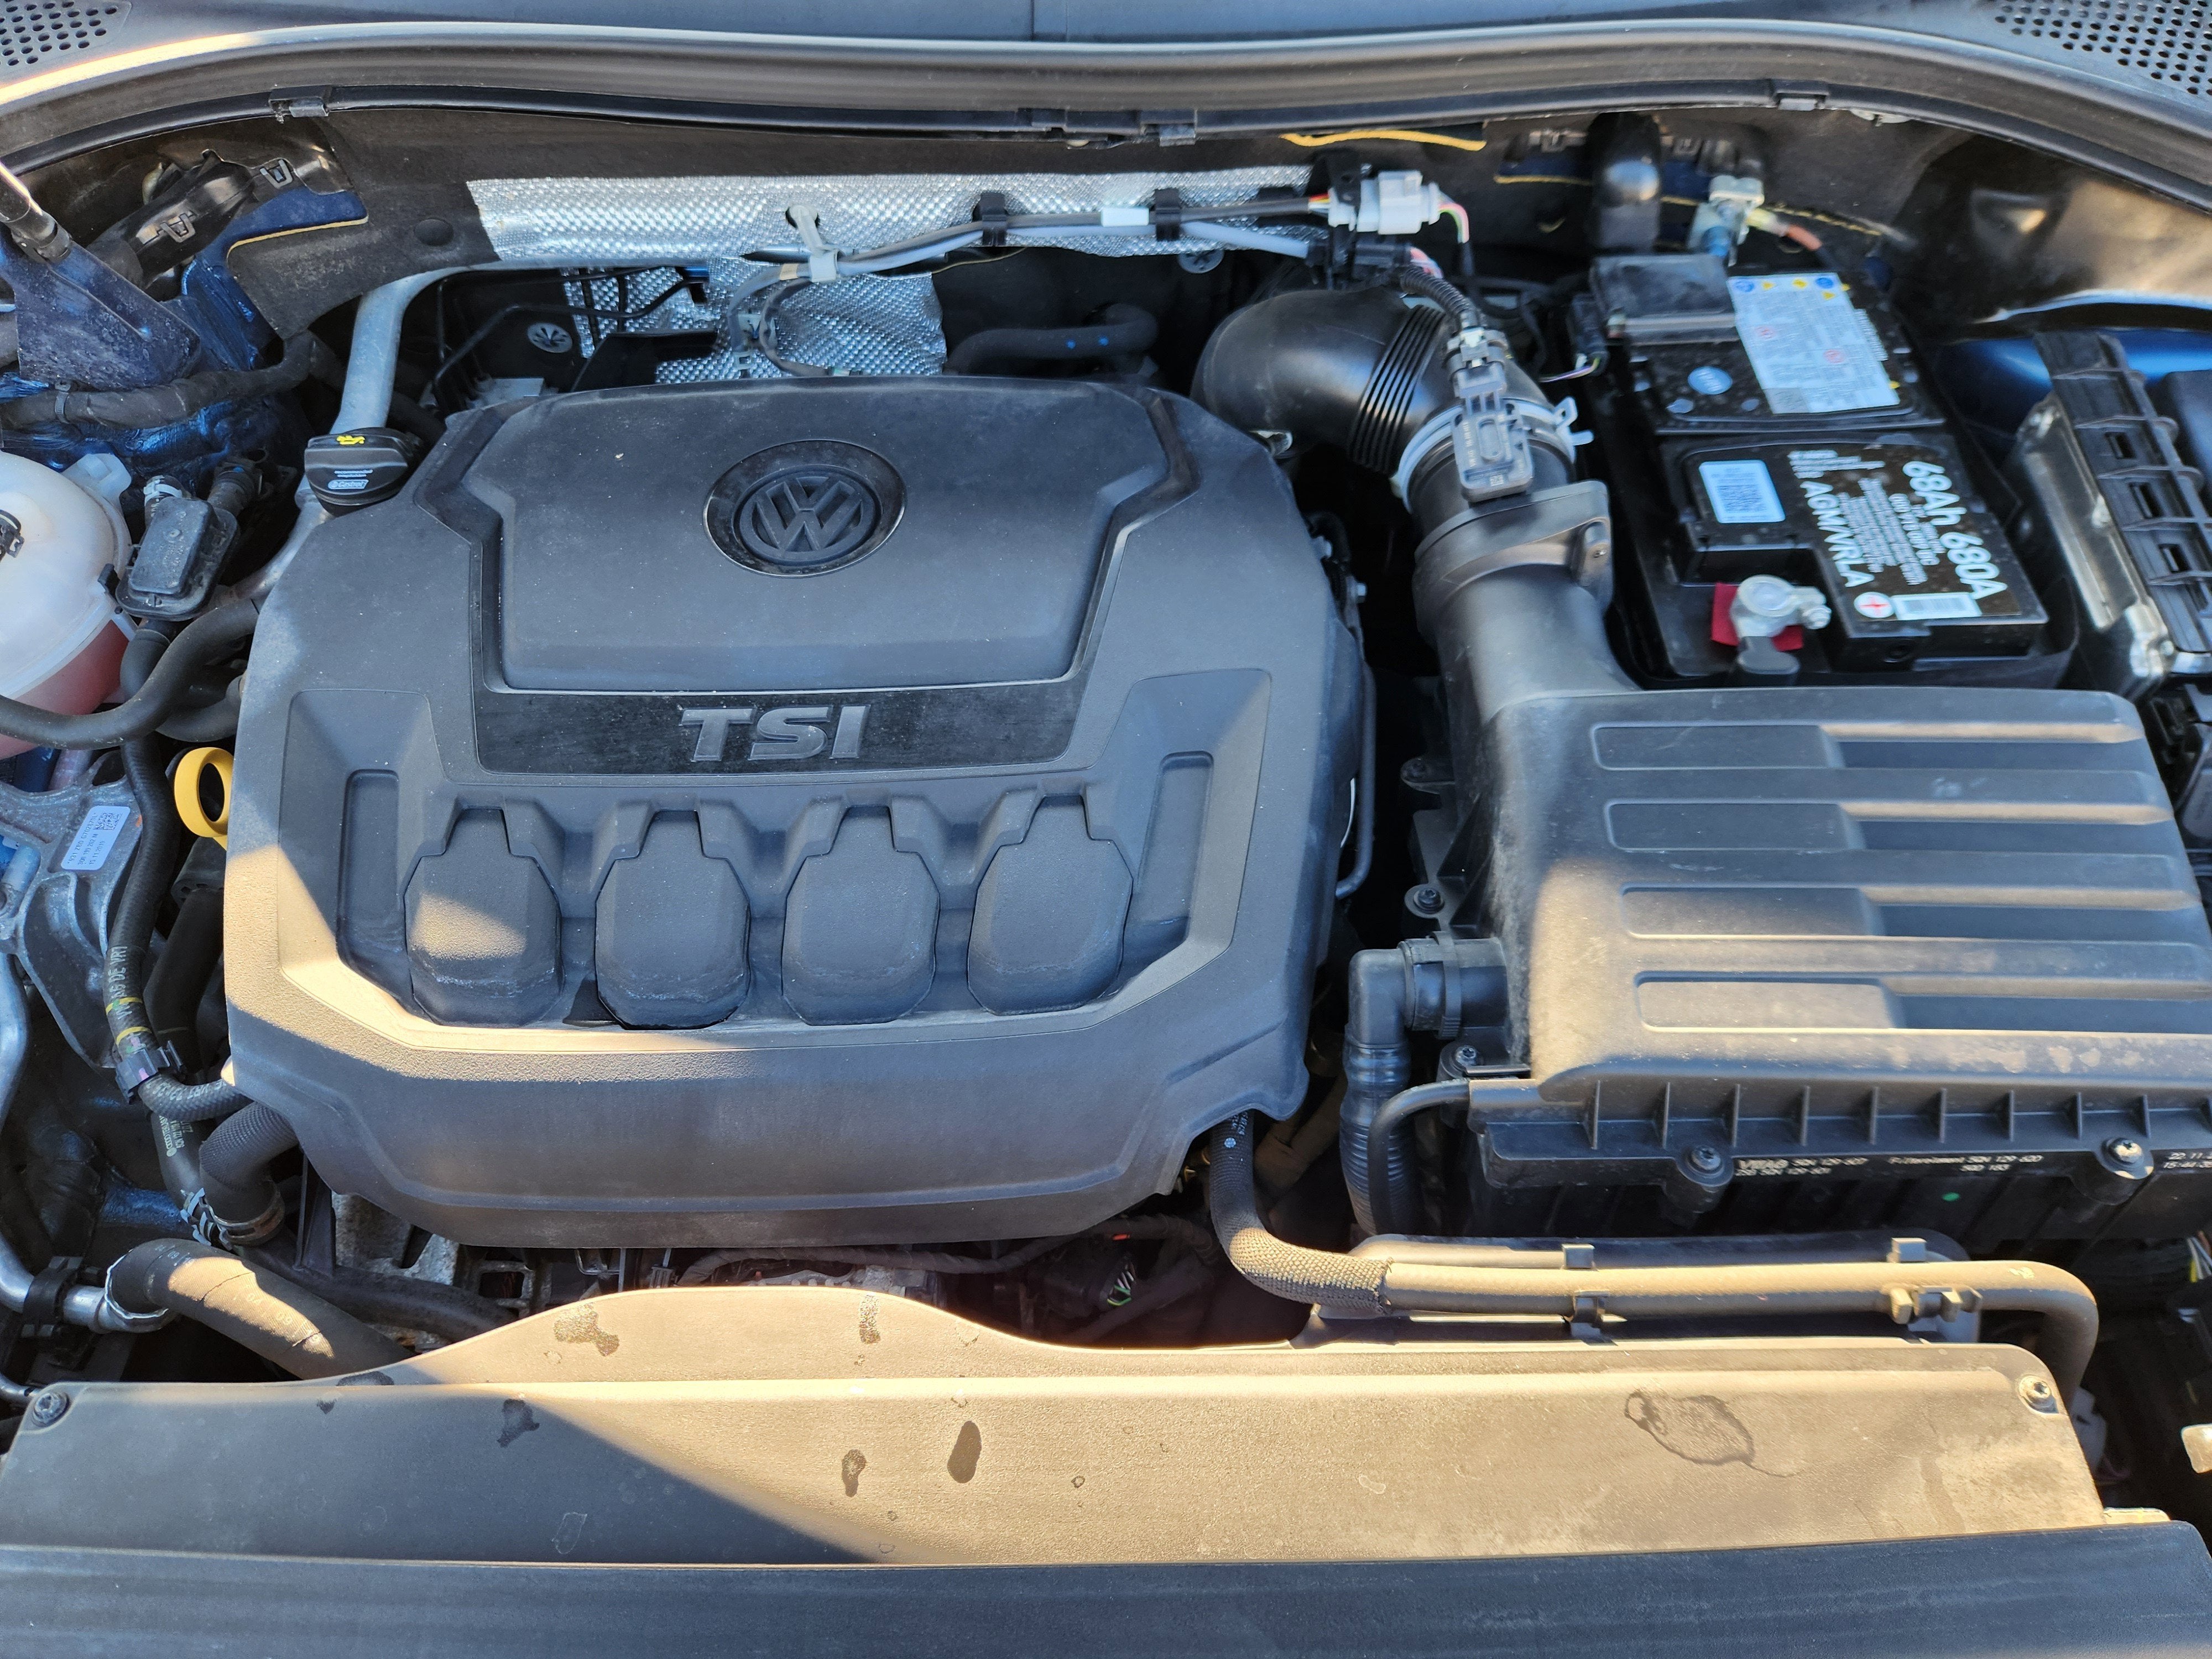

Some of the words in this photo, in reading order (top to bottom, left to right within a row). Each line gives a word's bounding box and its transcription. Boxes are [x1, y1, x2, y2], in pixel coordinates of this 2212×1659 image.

[744, 469, 876, 560] VW
[1799, 481, 1875, 587] AGM/VRLA
[1902, 461, 1967, 525] 68Ah
[1939, 532, 2007, 599] 680A
[680, 705, 870, 762] TSI
